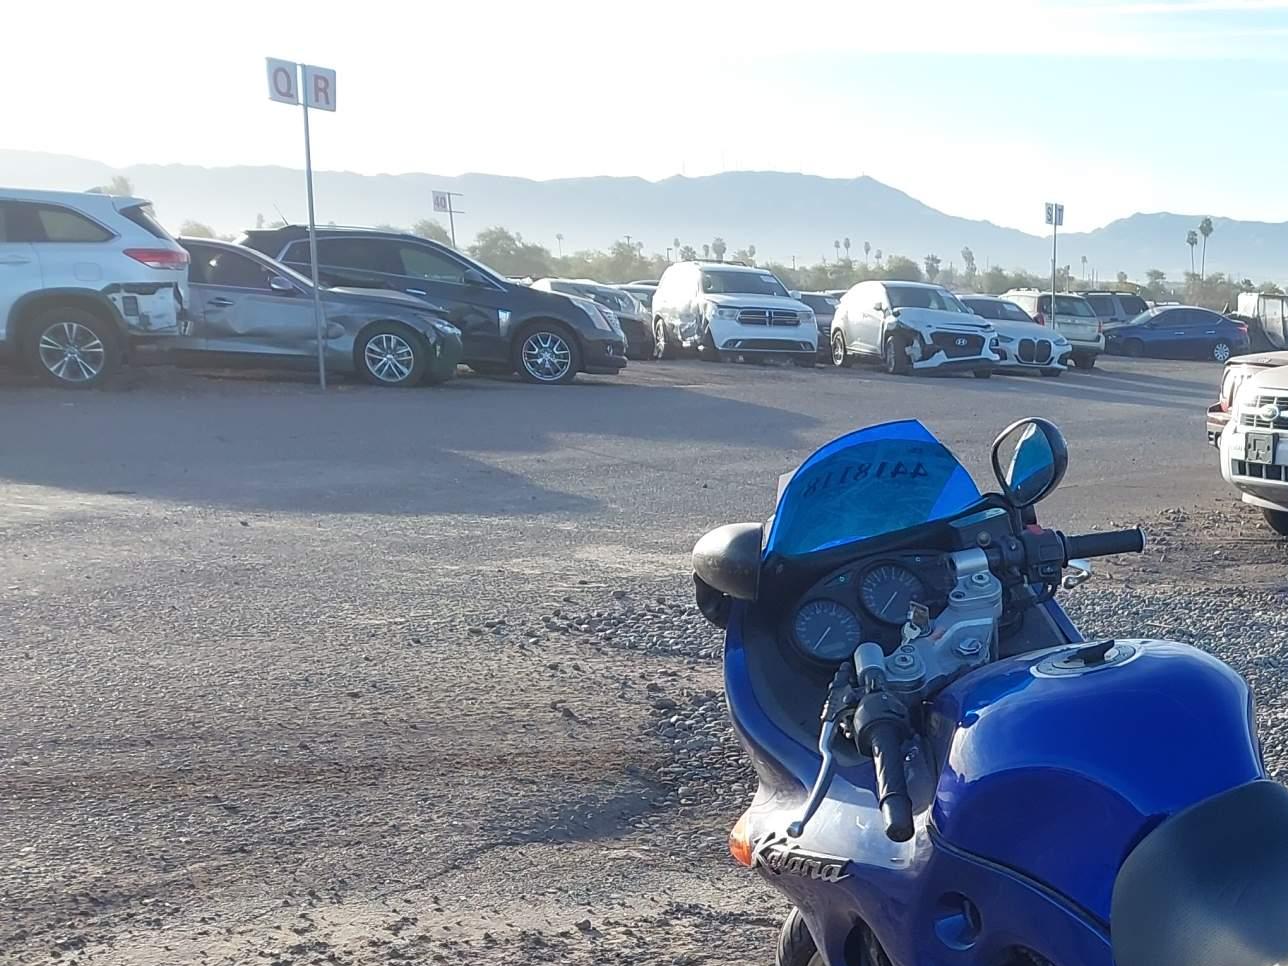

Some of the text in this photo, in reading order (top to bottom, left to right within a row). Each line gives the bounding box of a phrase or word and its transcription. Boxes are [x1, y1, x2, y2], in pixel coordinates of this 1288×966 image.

[273, 66, 293, 97] Q
[313, 74, 330, 105] R
[753, 832, 852, 883] Katana
